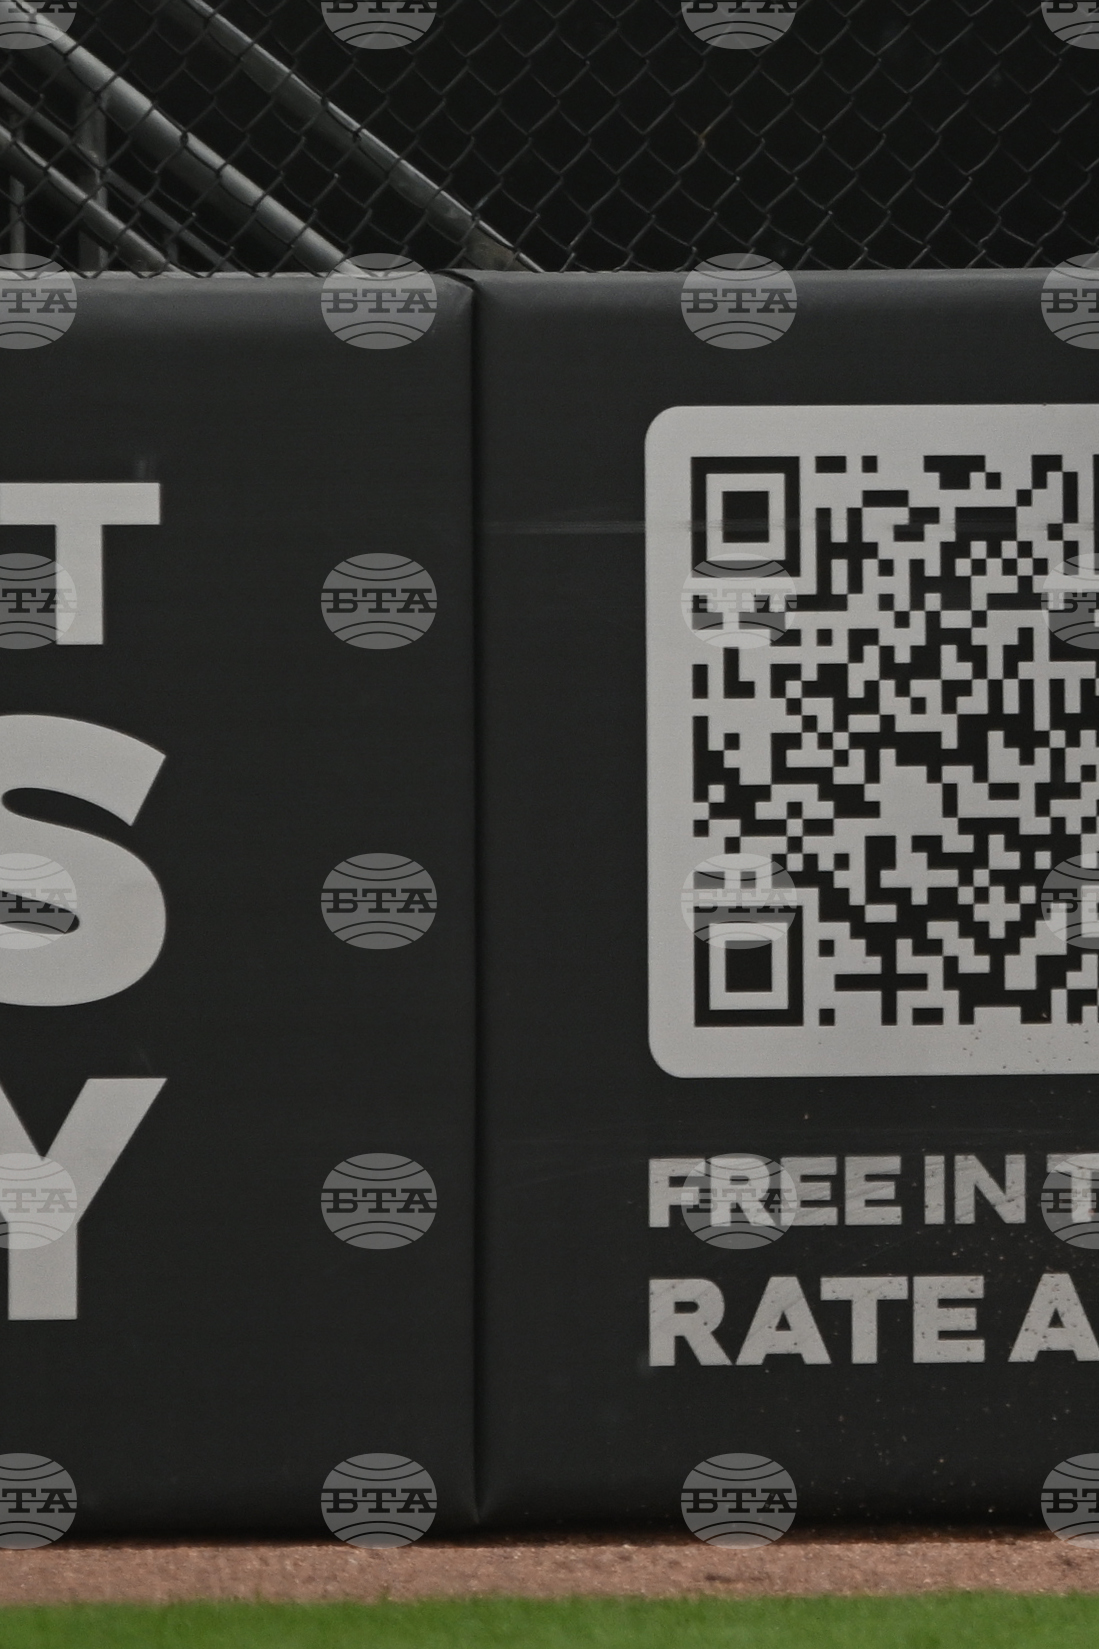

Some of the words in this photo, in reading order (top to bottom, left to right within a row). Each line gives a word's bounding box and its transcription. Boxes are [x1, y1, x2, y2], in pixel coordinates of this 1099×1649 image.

[647, 1155, 903, 1229] FREE
[924, 1153, 1027, 1225] IN
[647, 1274, 986, 1368] RATE
